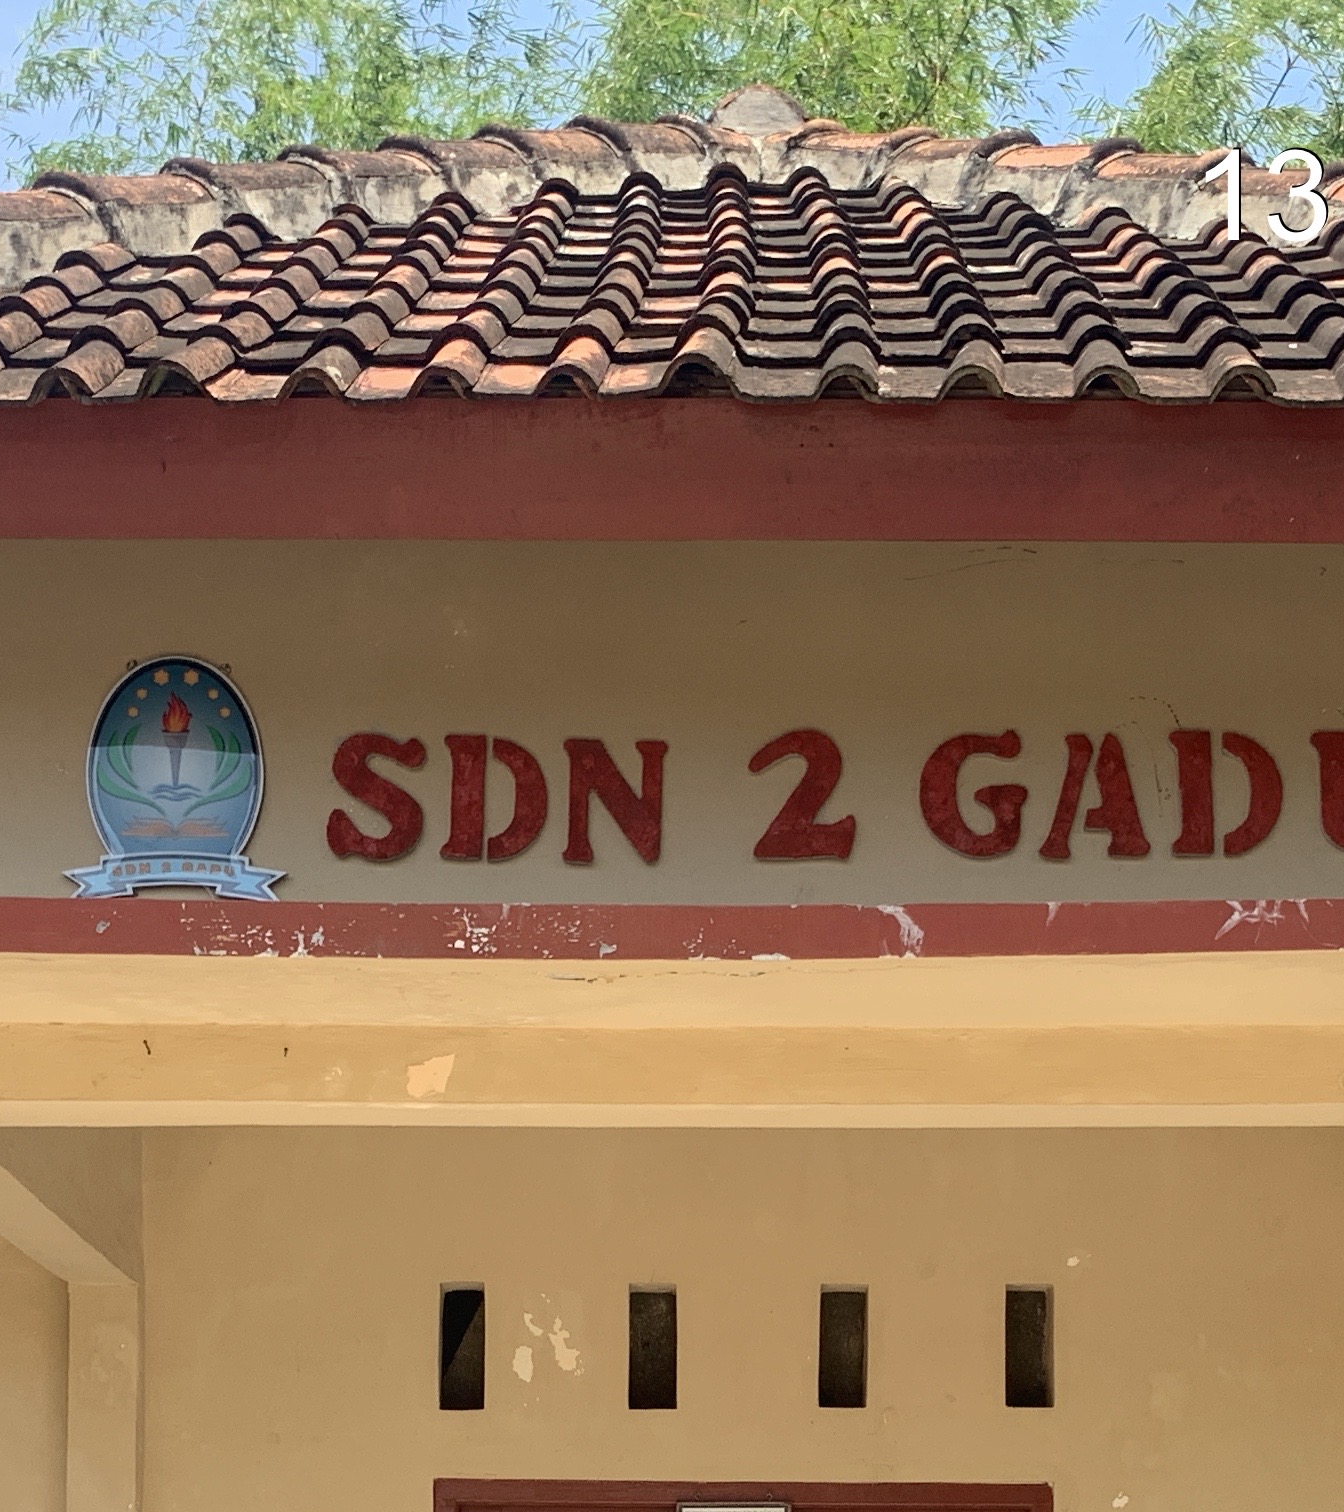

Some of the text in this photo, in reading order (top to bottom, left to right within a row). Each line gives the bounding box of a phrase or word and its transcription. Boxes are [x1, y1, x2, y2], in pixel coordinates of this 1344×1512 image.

[326, 733, 669, 864] SDN
[748, 729, 856, 862] 2
[112, 862, 151, 877] SDN
[161, 861, 172, 873] 2
